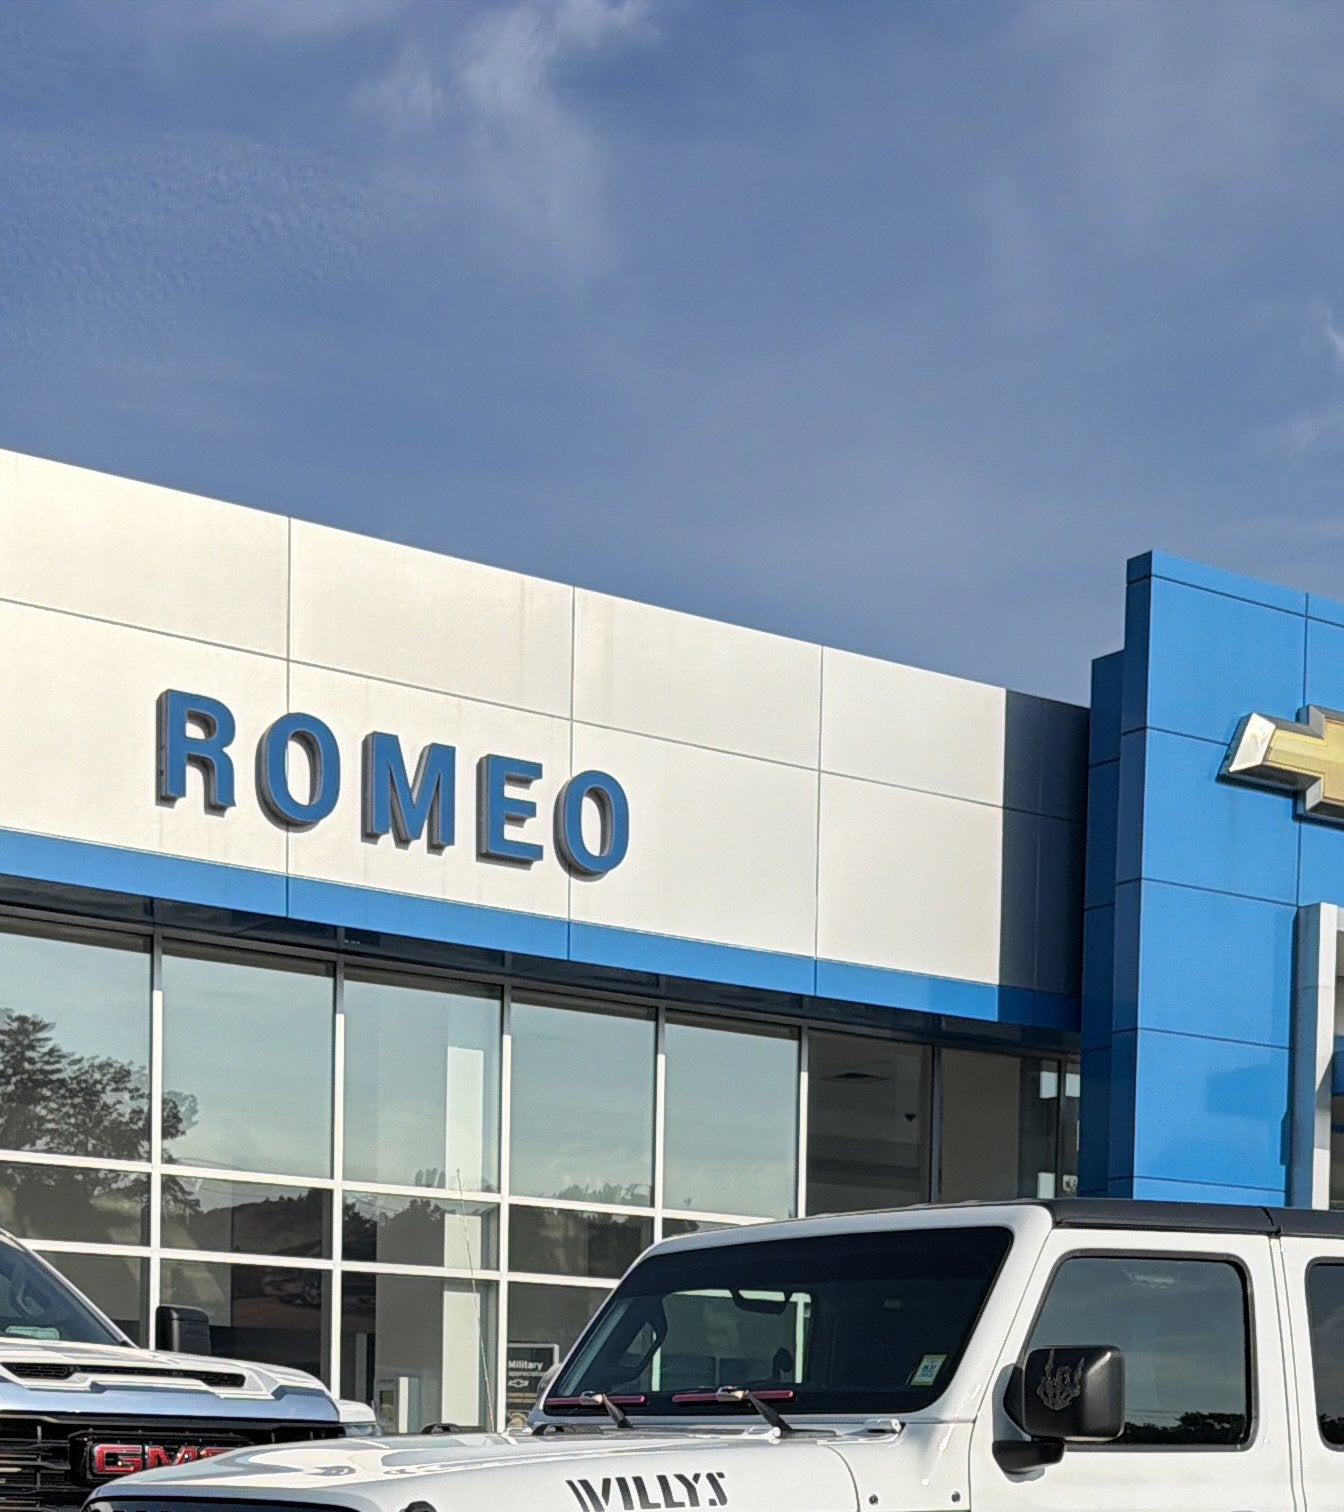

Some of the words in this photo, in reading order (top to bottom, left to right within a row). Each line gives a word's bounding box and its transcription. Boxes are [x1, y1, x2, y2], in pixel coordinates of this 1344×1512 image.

[156, 688, 630, 879] ROMEO
[508, 1359, 544, 1371] Military
[564, 1471, 728, 1512] WILLYS
